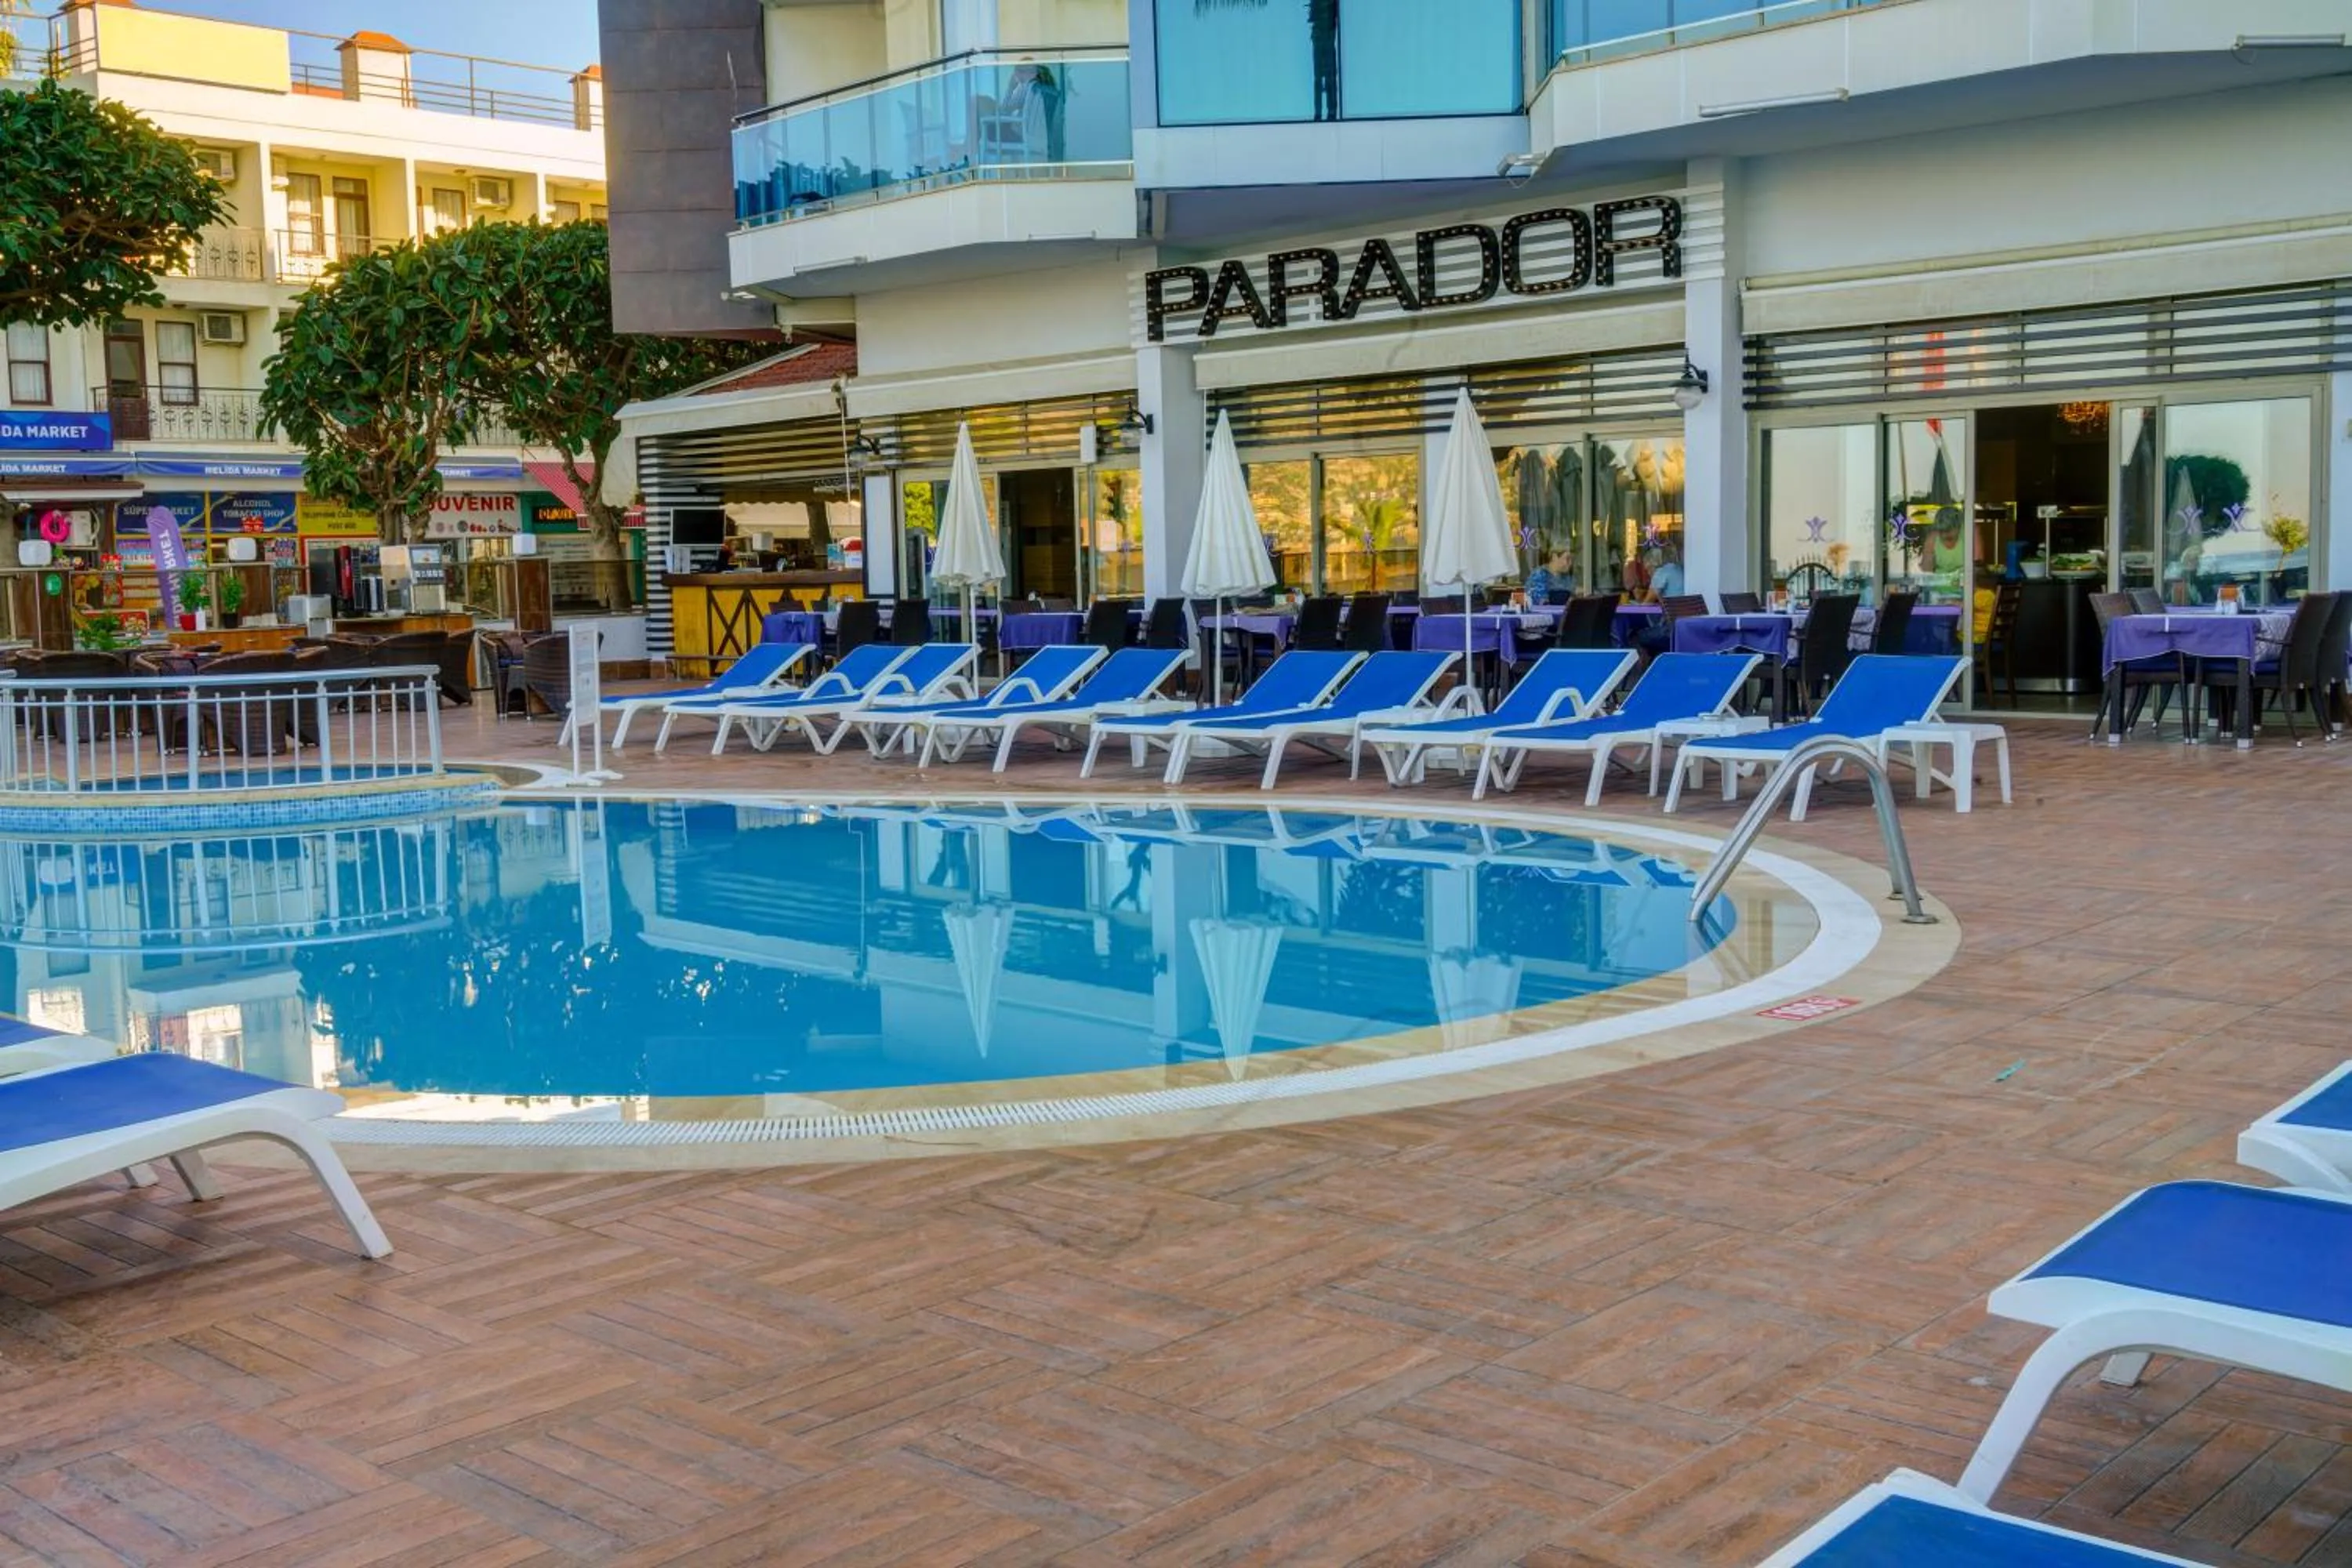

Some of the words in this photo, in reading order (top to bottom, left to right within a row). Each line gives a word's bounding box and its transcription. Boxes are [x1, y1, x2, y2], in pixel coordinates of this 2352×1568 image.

[1145, 194, 1682, 343] PARADOR
[26, 425, 89, 438] MARKET
[22, 464, 67, 473] MARKET
[263, 509, 285, 517] SHOP
